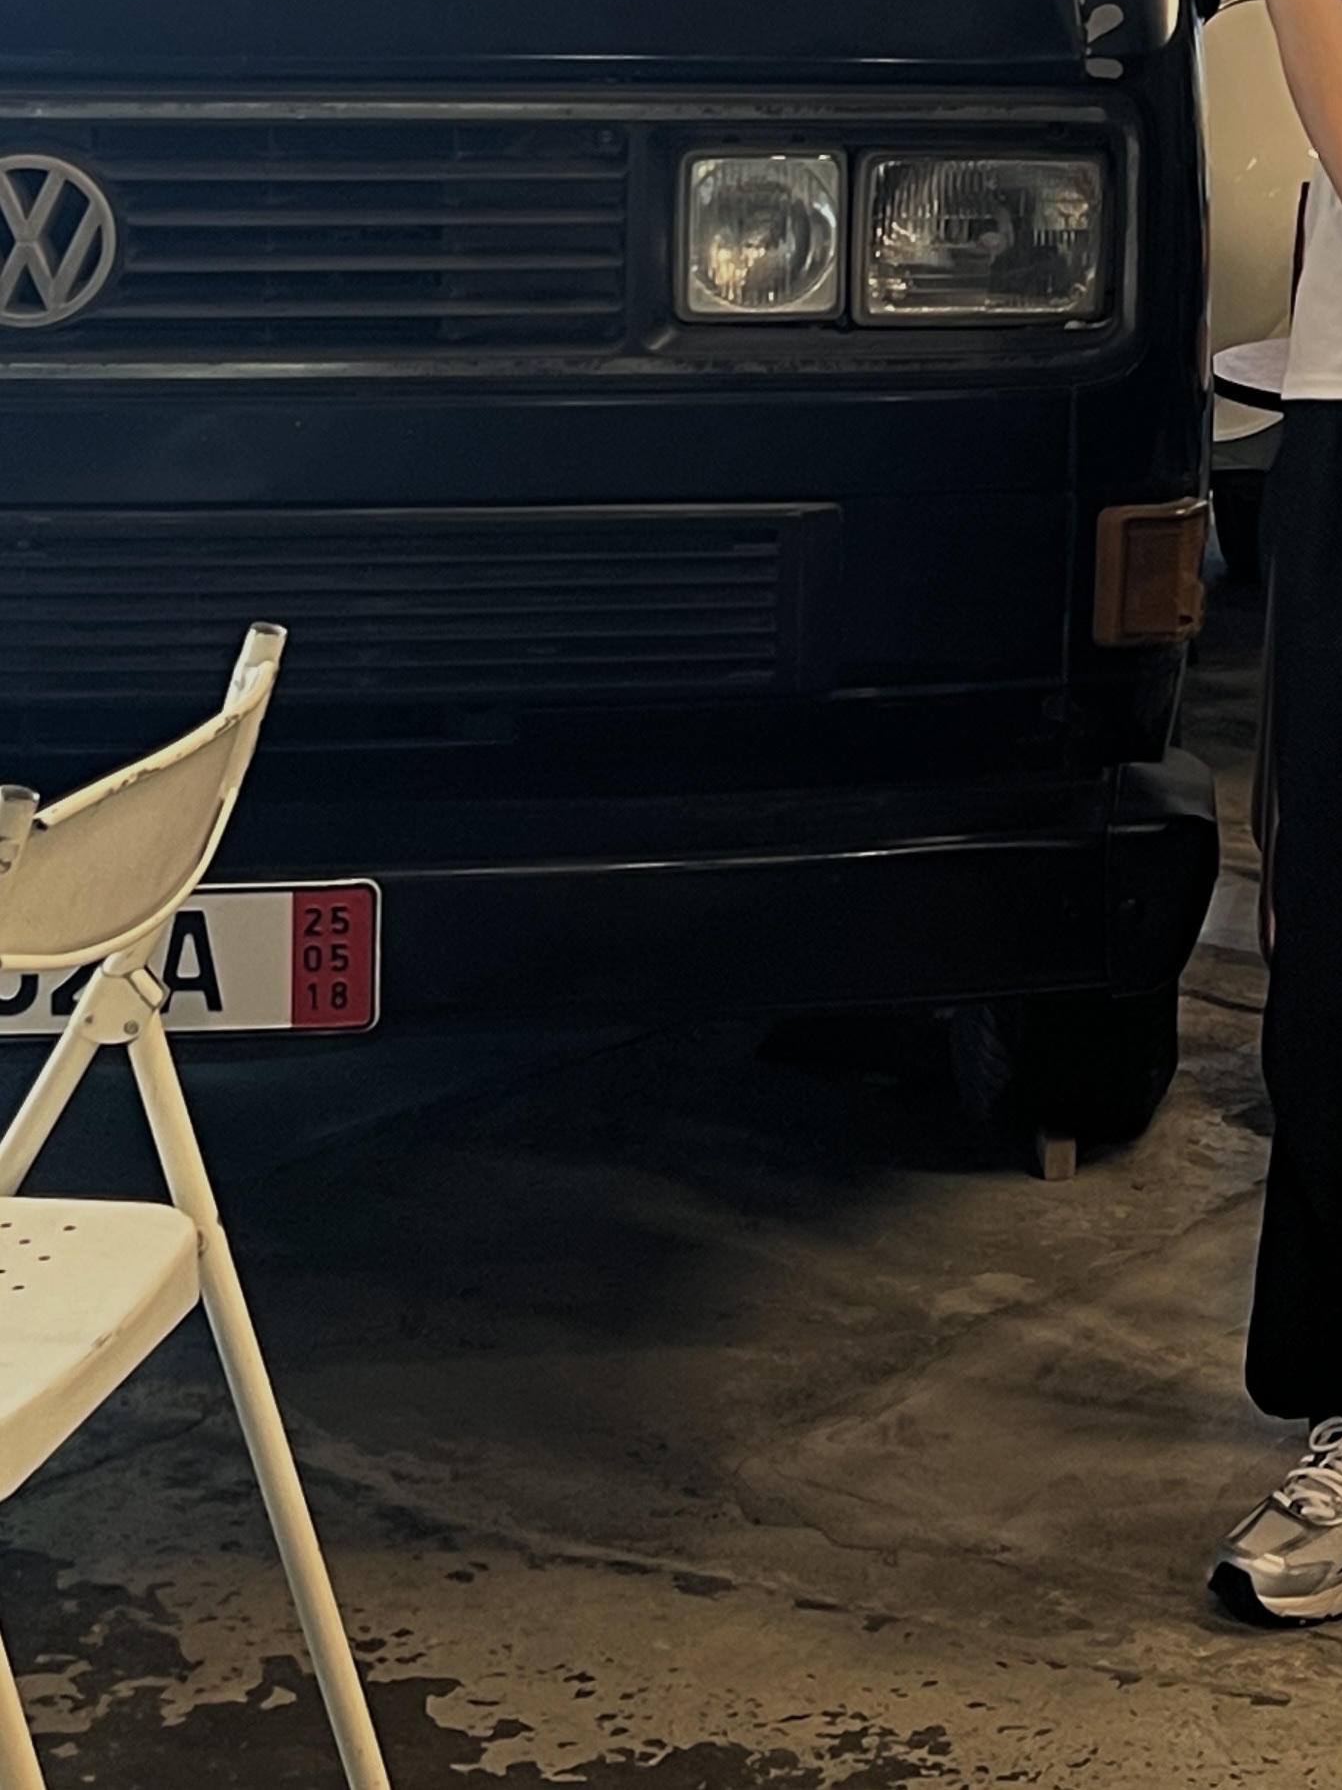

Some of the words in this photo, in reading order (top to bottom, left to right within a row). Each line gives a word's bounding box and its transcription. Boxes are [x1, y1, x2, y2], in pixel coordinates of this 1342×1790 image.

[303, 905, 350, 937] 25
[303, 943, 350, 973] 05
[307, 980, 349, 1010] 18
